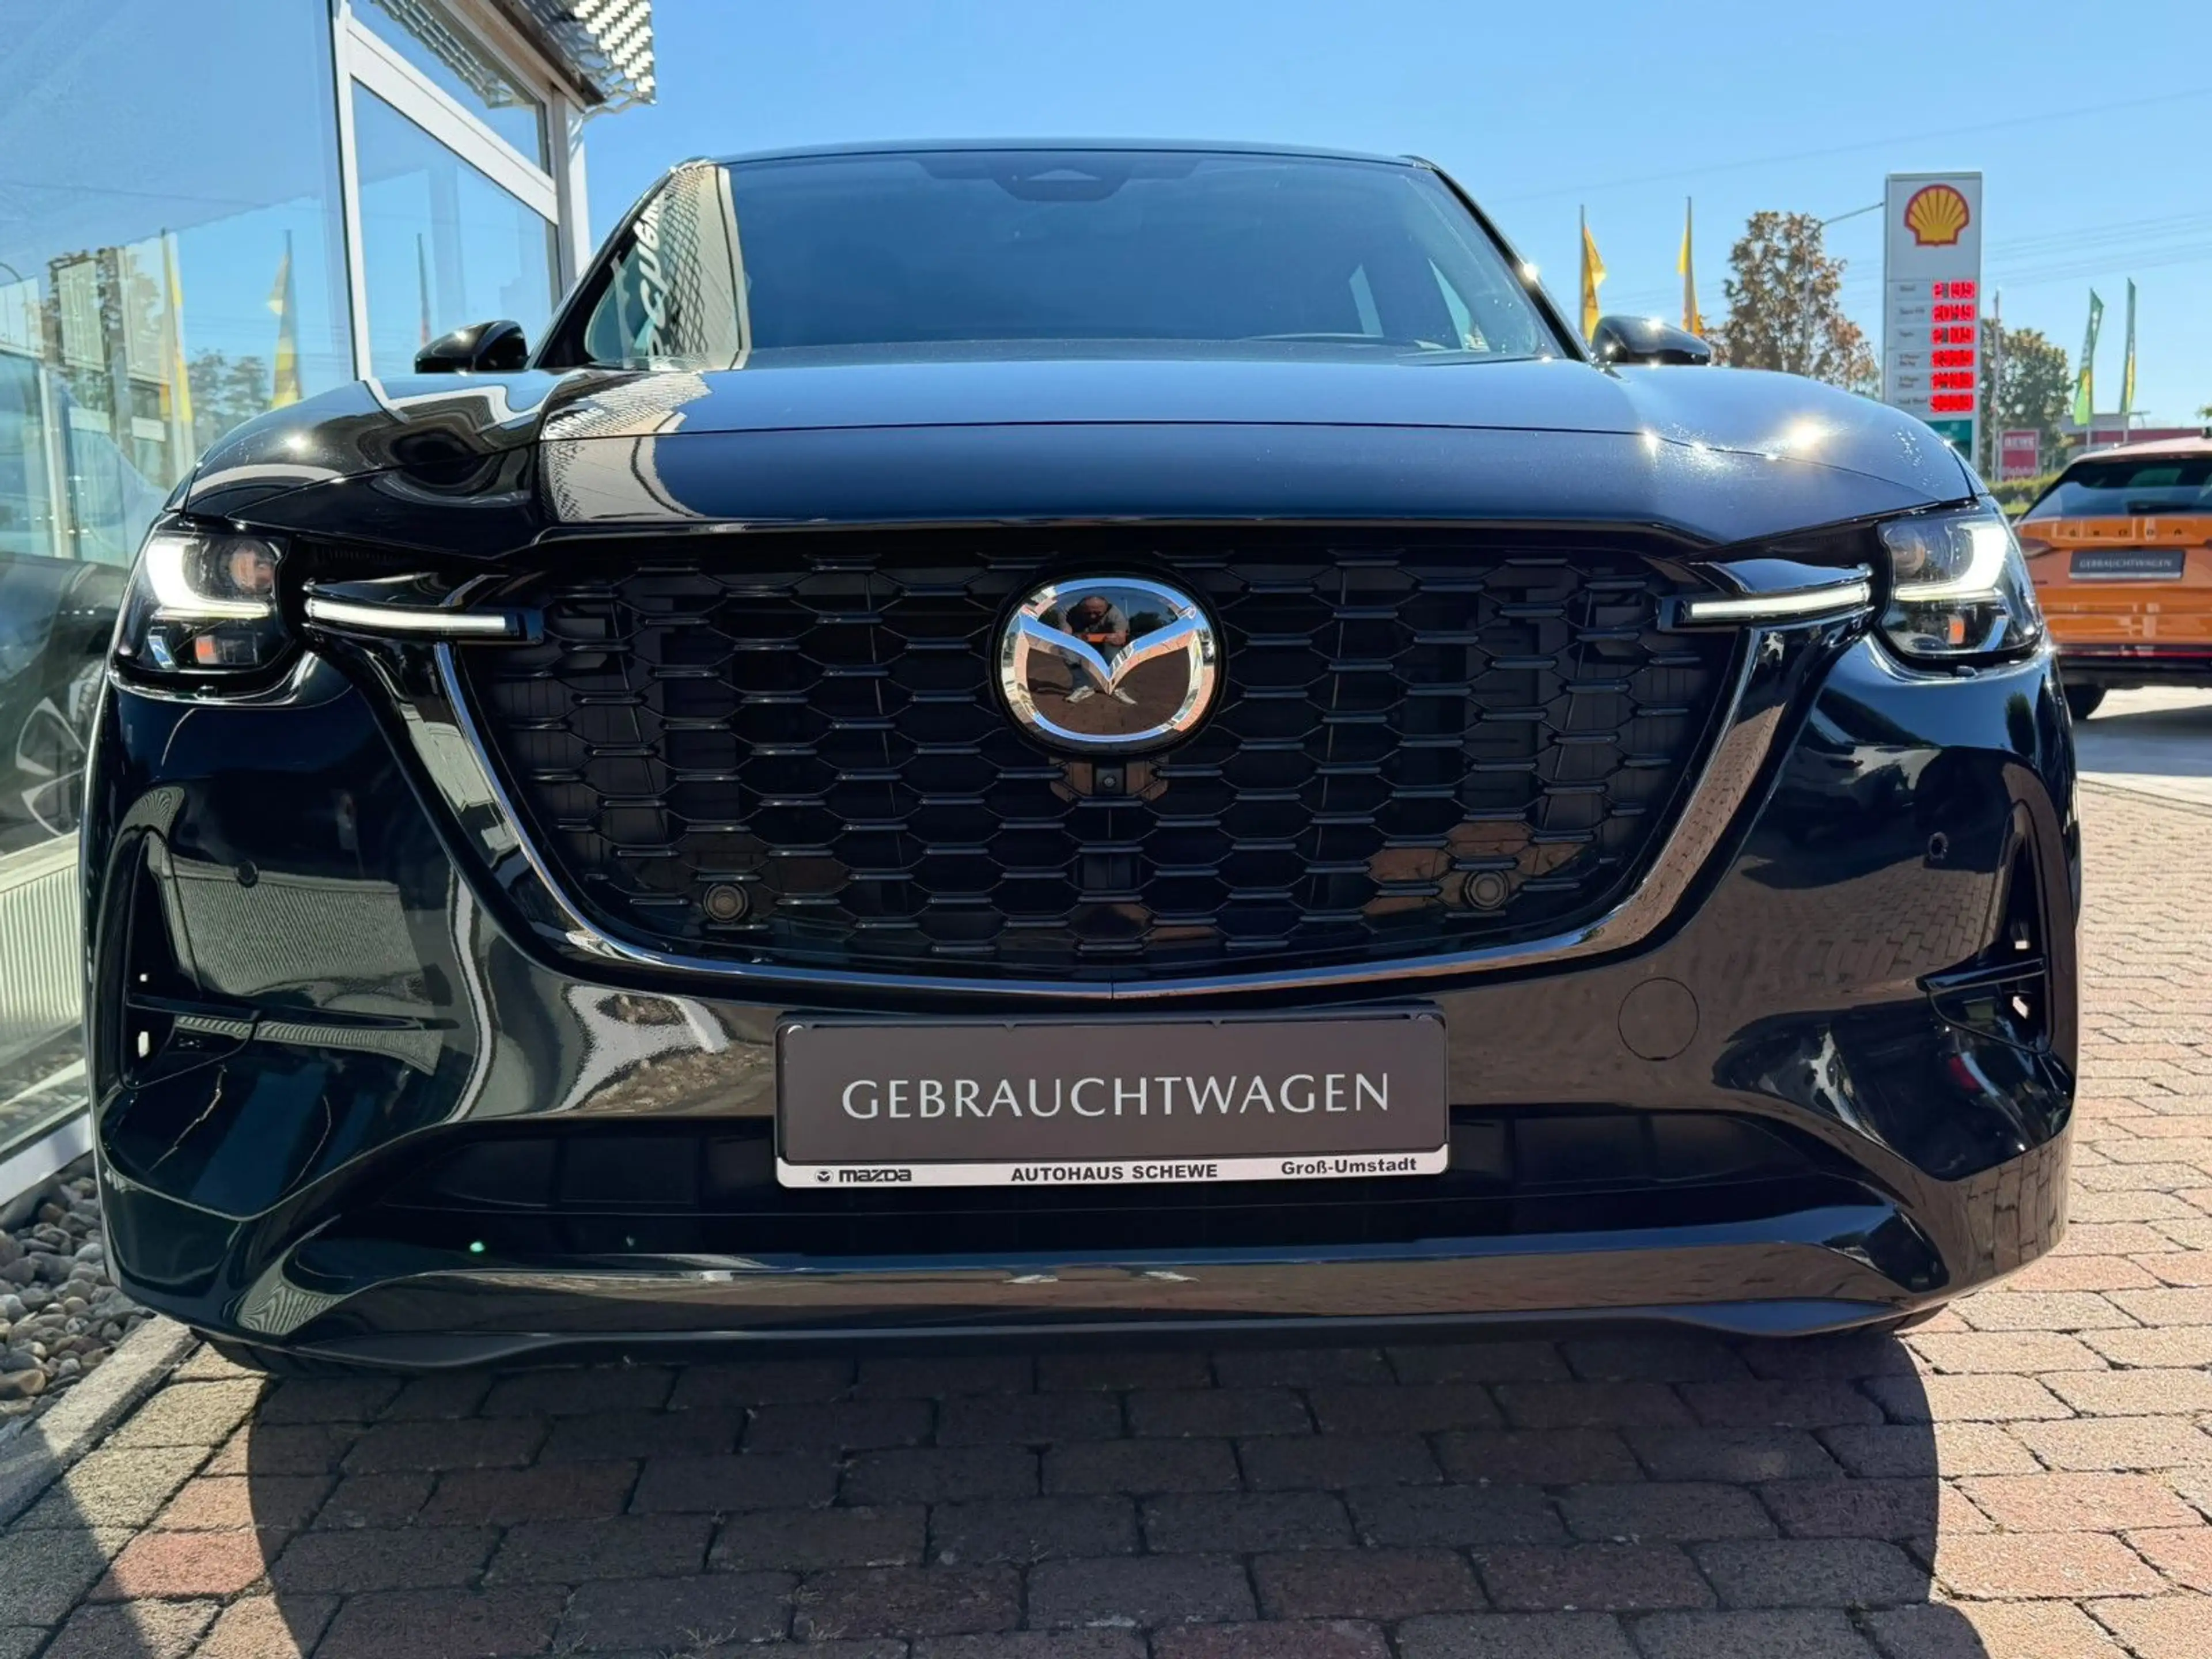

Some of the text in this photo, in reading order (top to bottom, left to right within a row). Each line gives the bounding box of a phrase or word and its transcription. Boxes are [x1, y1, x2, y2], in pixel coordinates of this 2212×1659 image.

[840, 1072, 1388, 1119] GEBRAUCHTWAGEN
[1010, 1163, 1218, 1182] AUTOHAUS SCHEWE
[1281, 1157, 1417, 1176] Groß-Umstadt
